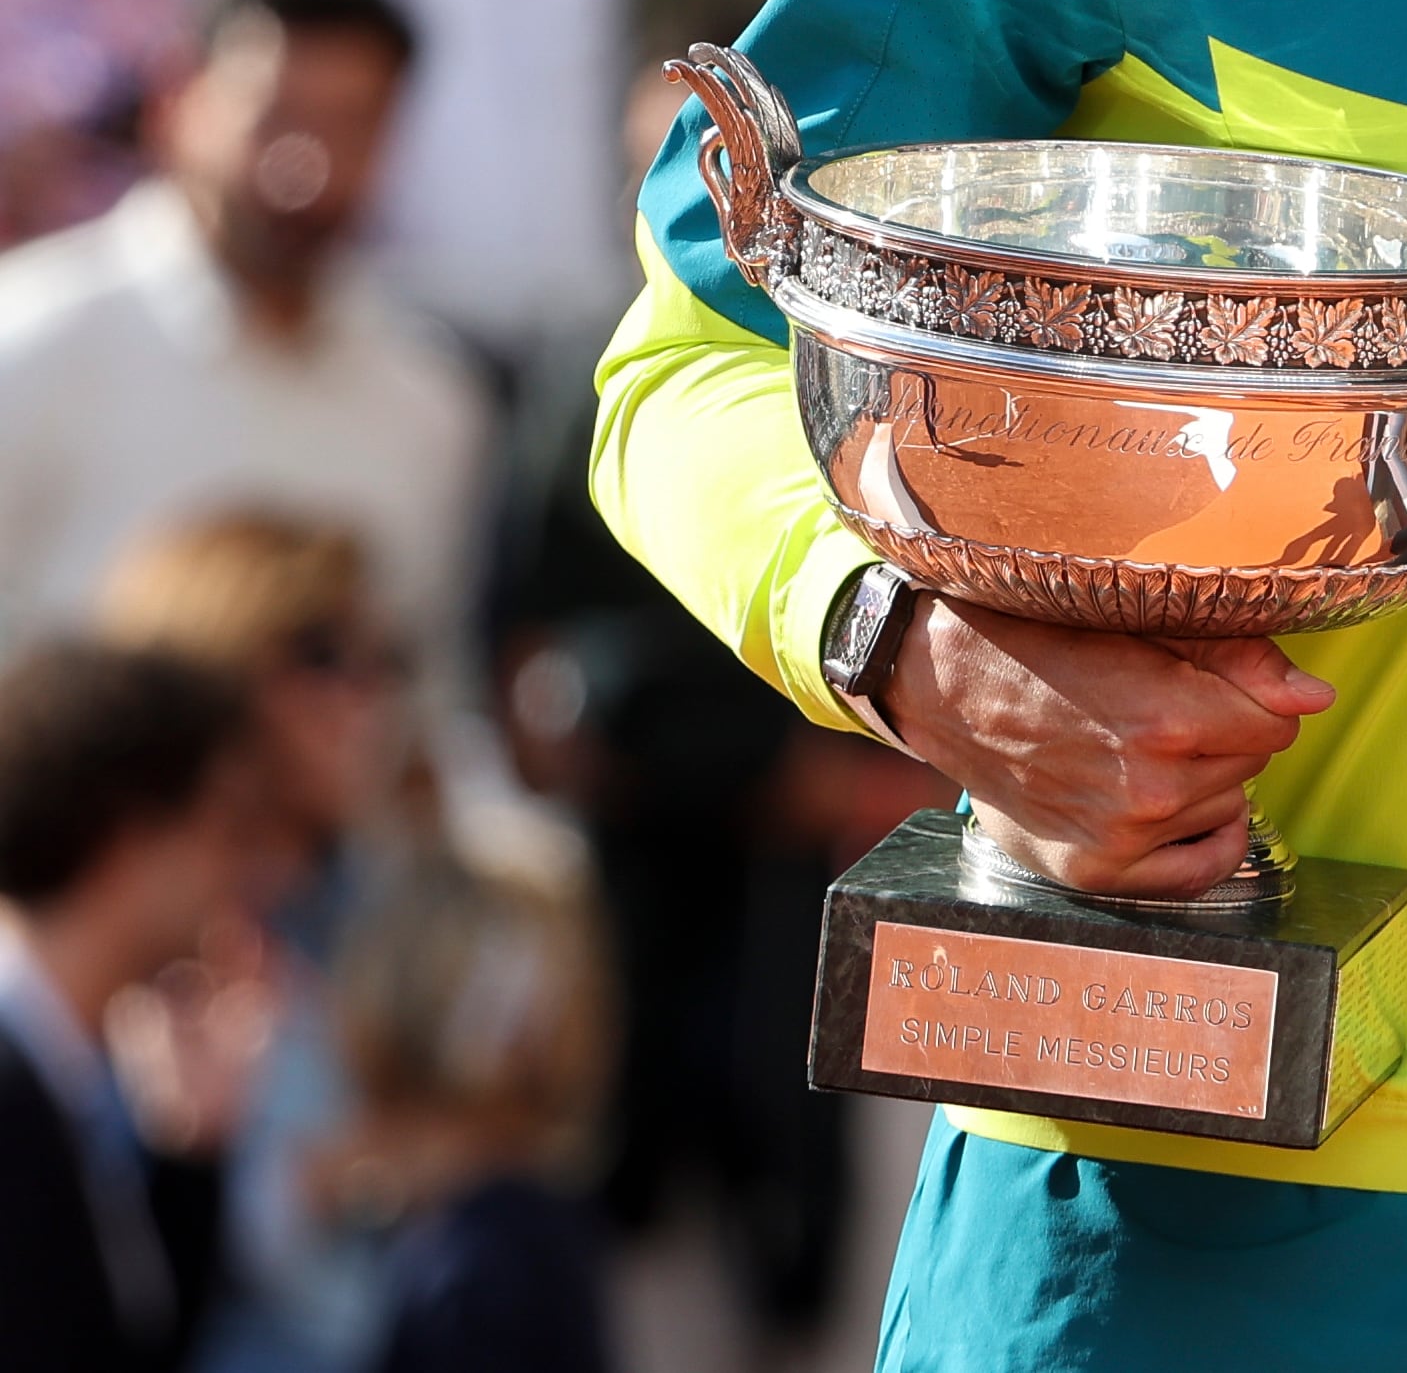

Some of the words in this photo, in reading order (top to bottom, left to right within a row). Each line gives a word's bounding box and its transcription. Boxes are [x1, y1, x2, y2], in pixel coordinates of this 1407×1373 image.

[1222, 422, 1275, 461] de
[888, 959, 1061, 1007] ROLAND
[1082, 983, 1253, 1029] GARROS
[900, 1017, 1023, 1057] SIMPLE
[1038, 1035, 1230, 1084] MESSIEURS
